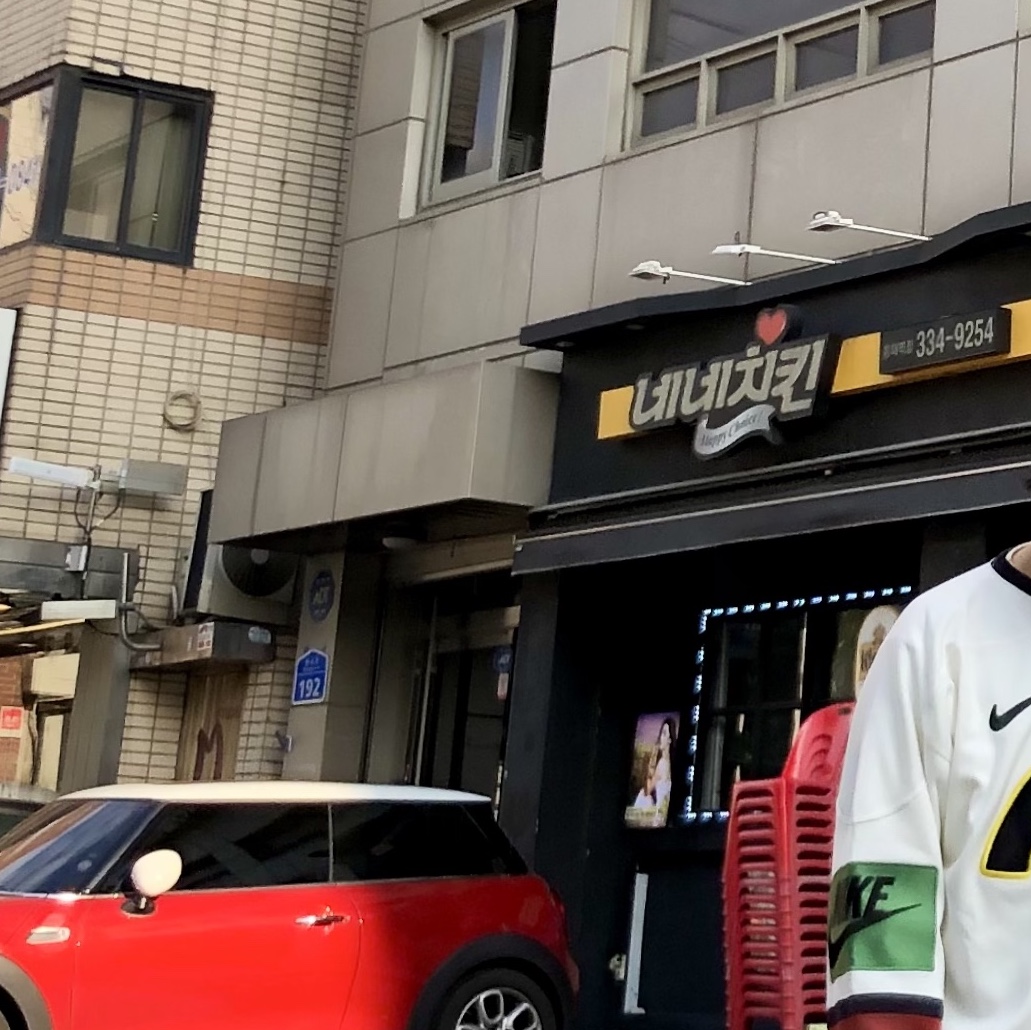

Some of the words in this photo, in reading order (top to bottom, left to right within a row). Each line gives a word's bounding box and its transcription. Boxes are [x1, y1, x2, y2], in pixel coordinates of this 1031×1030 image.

[916, 316, 994, 358] 334-9254
[632, 339, 826, 426] 네네치킨
[299, 677, 321, 699] 192
